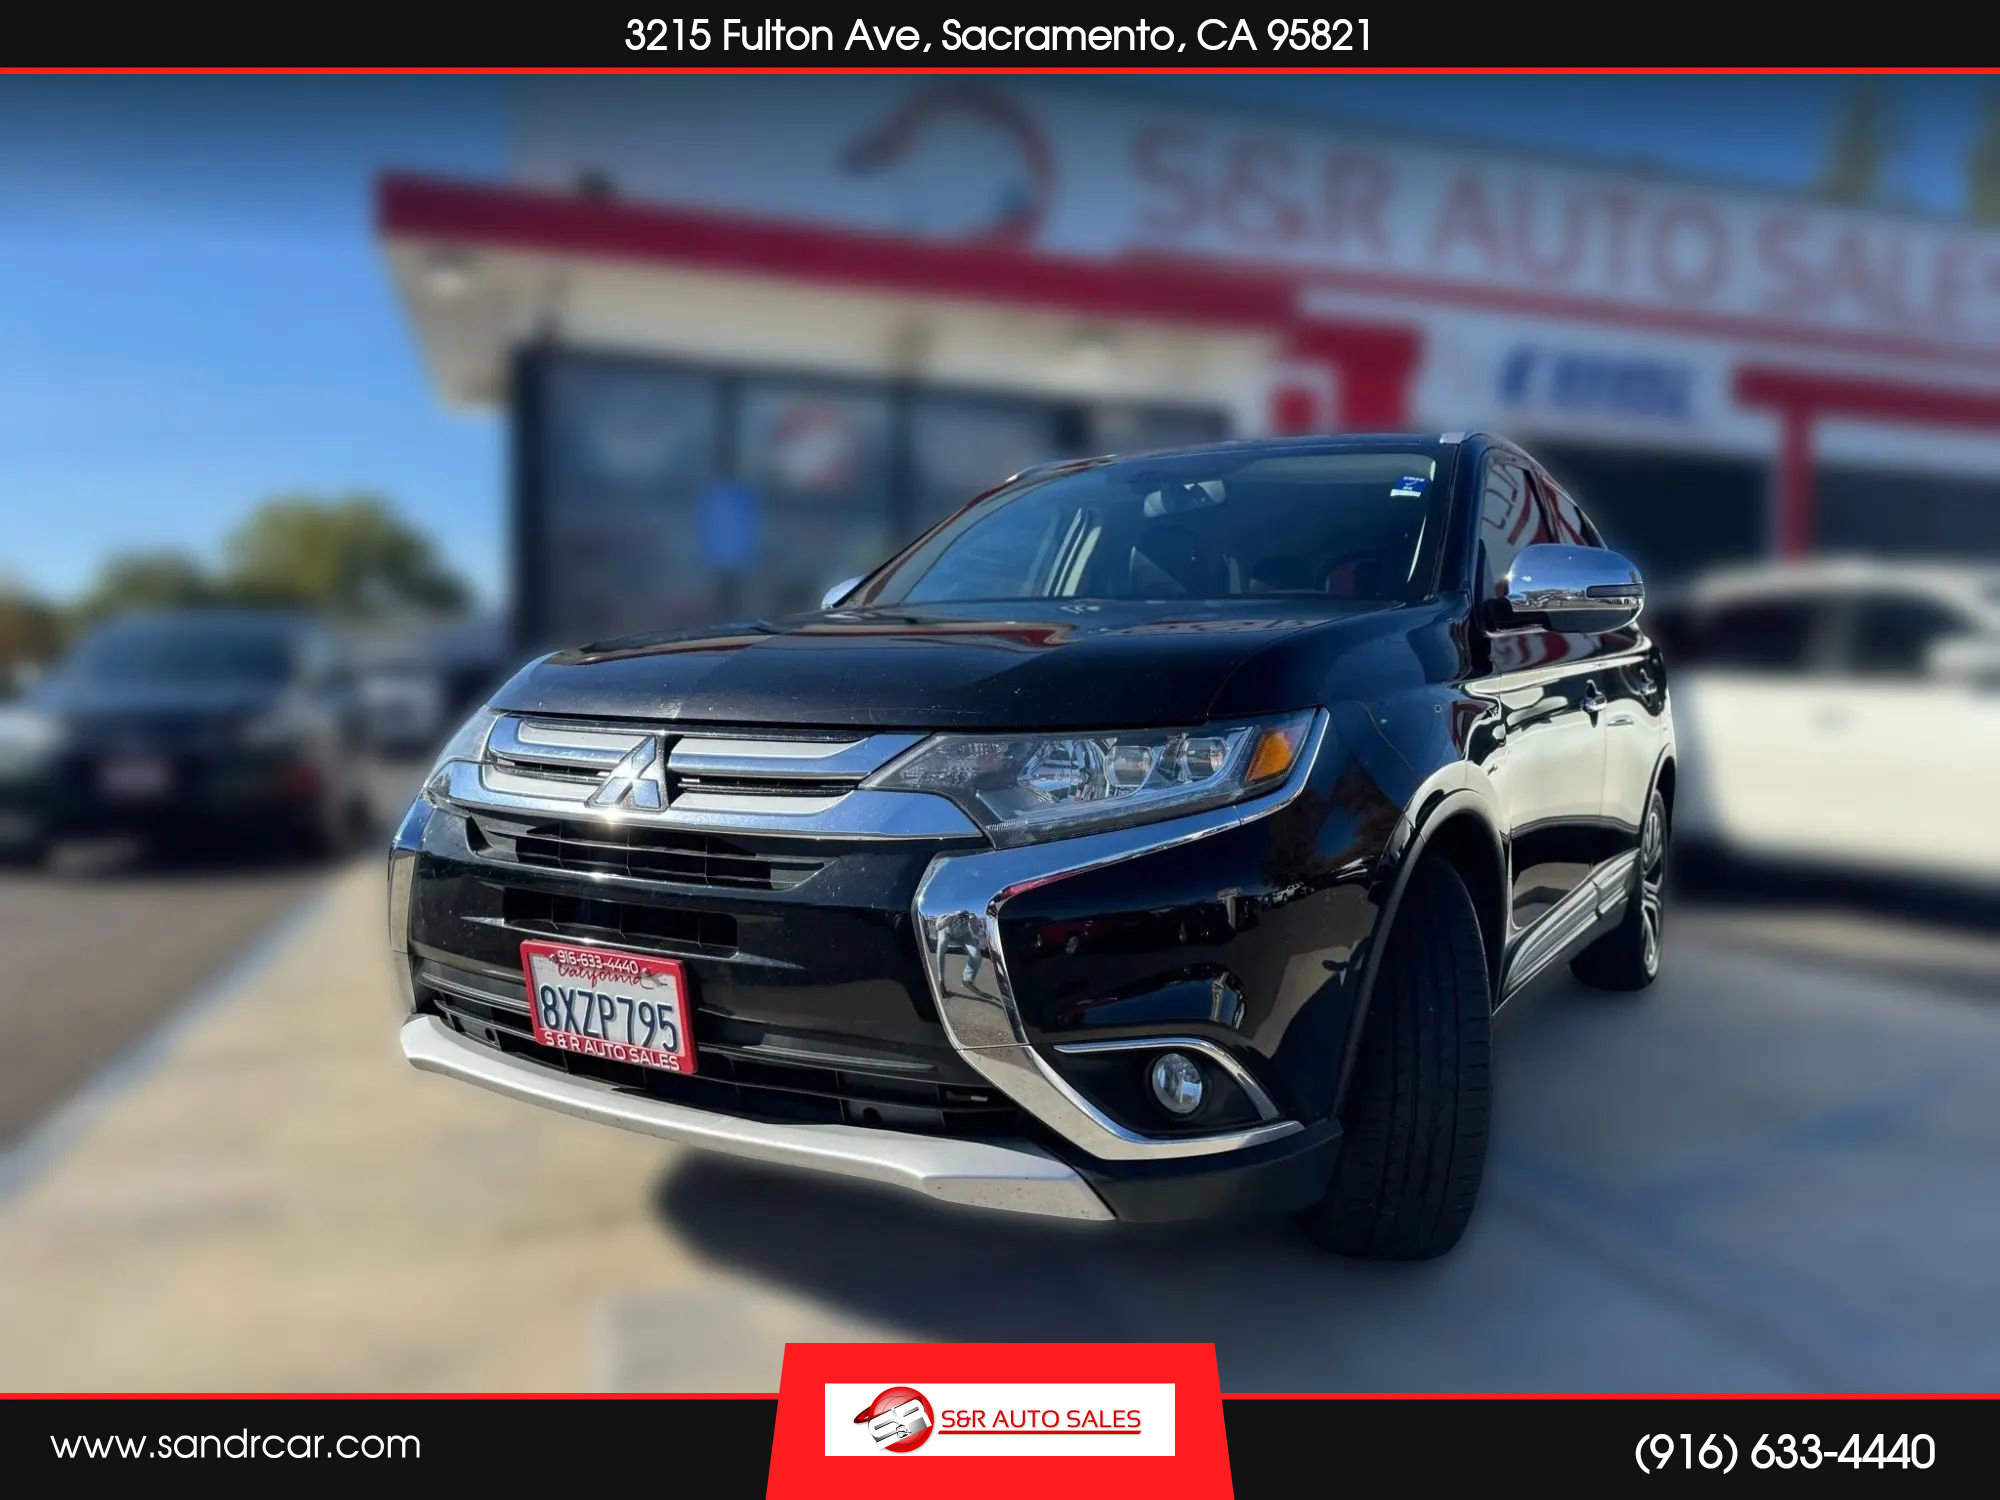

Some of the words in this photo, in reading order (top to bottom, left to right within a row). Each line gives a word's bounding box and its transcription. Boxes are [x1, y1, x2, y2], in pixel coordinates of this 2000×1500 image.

[1430, 160, 1731, 303] AUTO
[1756, 210, 2000, 338] SALE
[557, 950, 639, 974] 916-633-4440
[540, 985, 678, 1053] 8XZP795
[544, 1031, 555, 1046] S
[557, 1034, 568, 1049] &
[570, 1037, 581, 1052] R
[584, 1039, 626, 1060] AUTO
[629, 1049, 680, 1071] SALES
